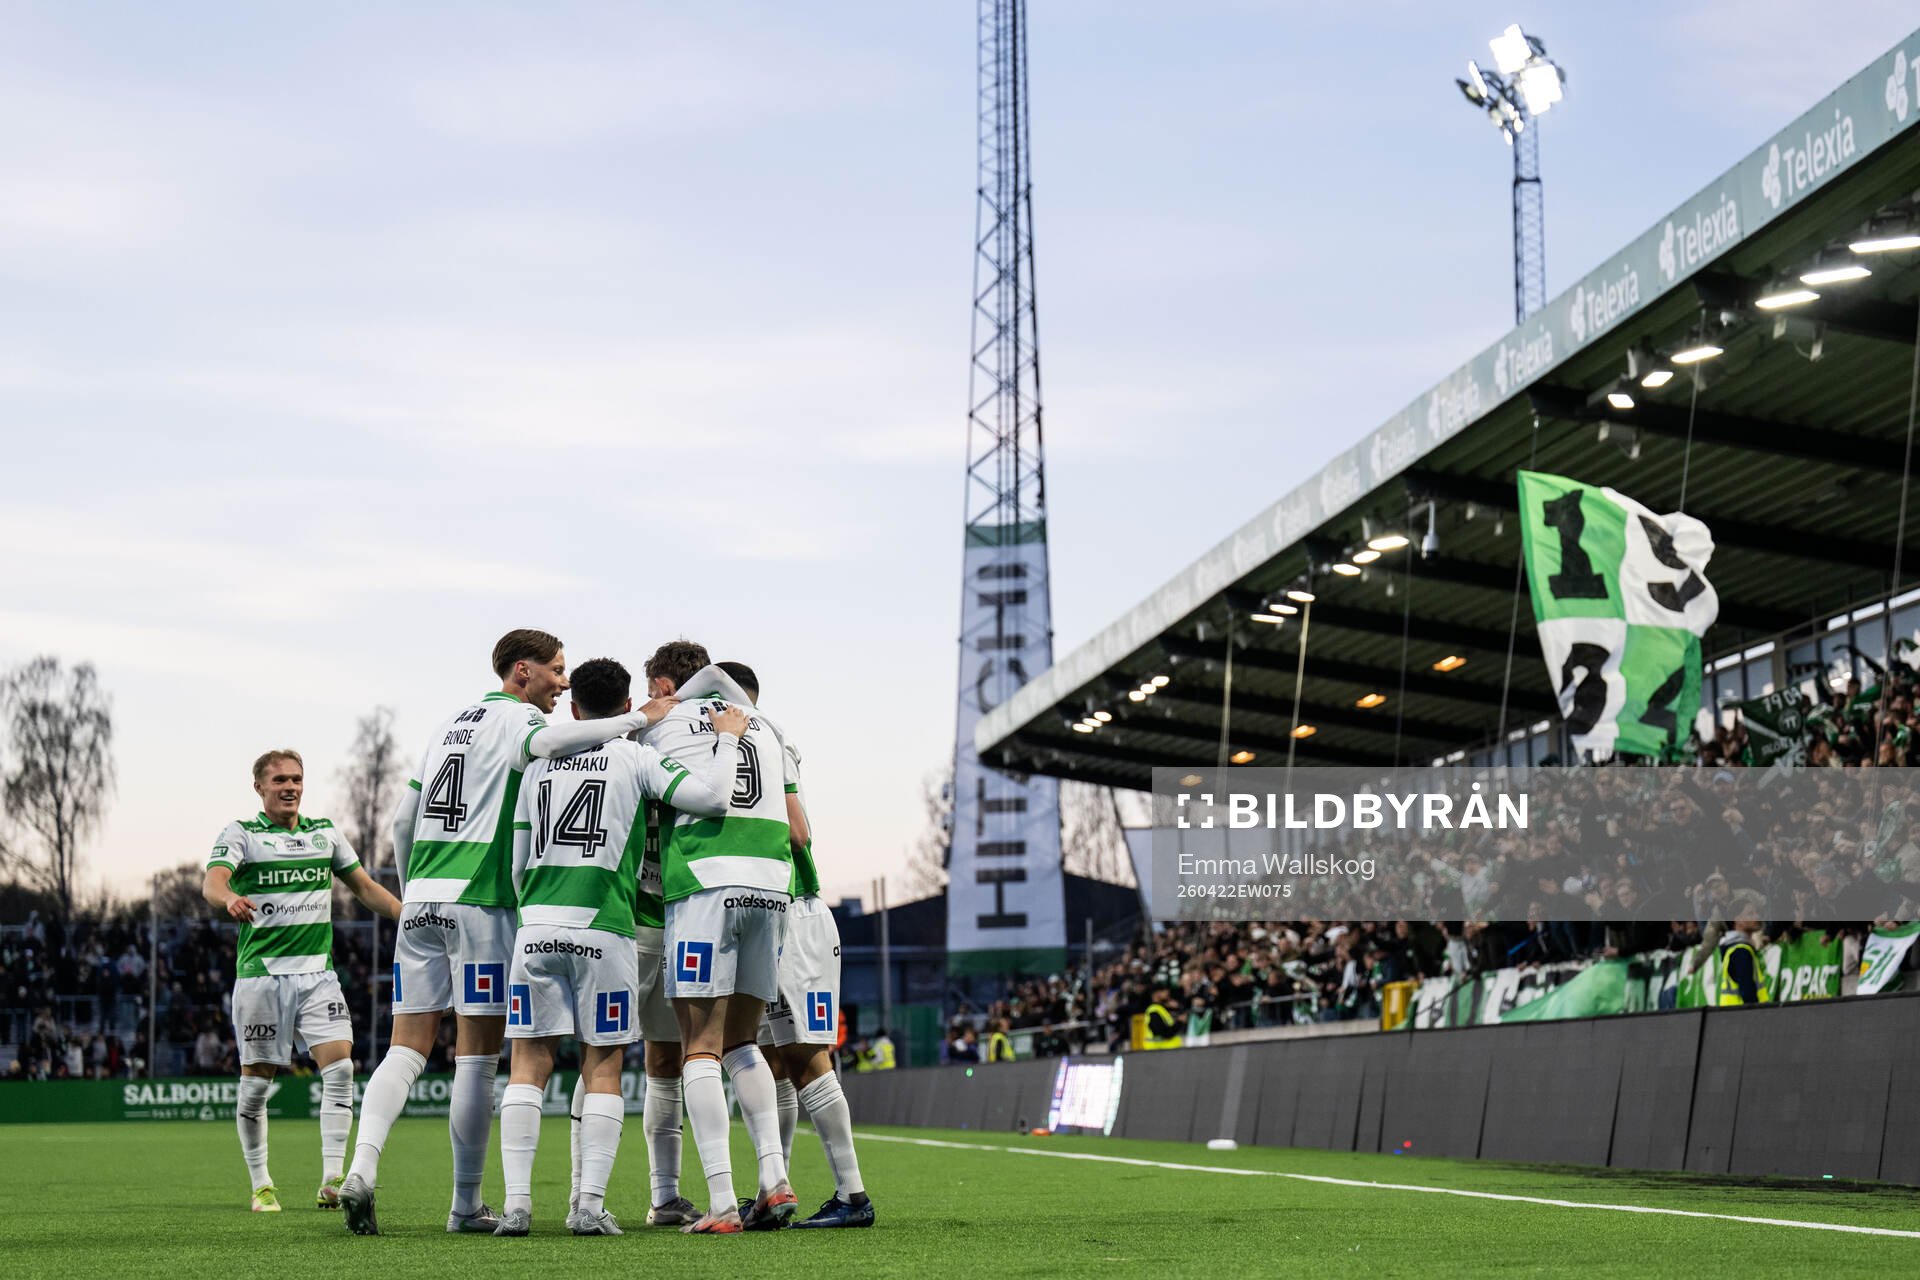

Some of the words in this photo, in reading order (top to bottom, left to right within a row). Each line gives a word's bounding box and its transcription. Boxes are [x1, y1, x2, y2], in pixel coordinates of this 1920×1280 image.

[1783, 108, 1855, 196] Telexia
[1676, 193, 1738, 270] Telexia
[1586, 263, 1640, 333] Telexia
[1508, 324, 1554, 387] Telexia
[443, 729, 475, 746] BONDE
[547, 756, 609, 773] LUSHAKU
[976, 564, 1028, 930] HITCHI
[423, 753, 467, 832] 4
[536, 779, 608, 859] 14
[724, 894, 787, 913] axelssons
[524, 939, 603, 960] axelssons
